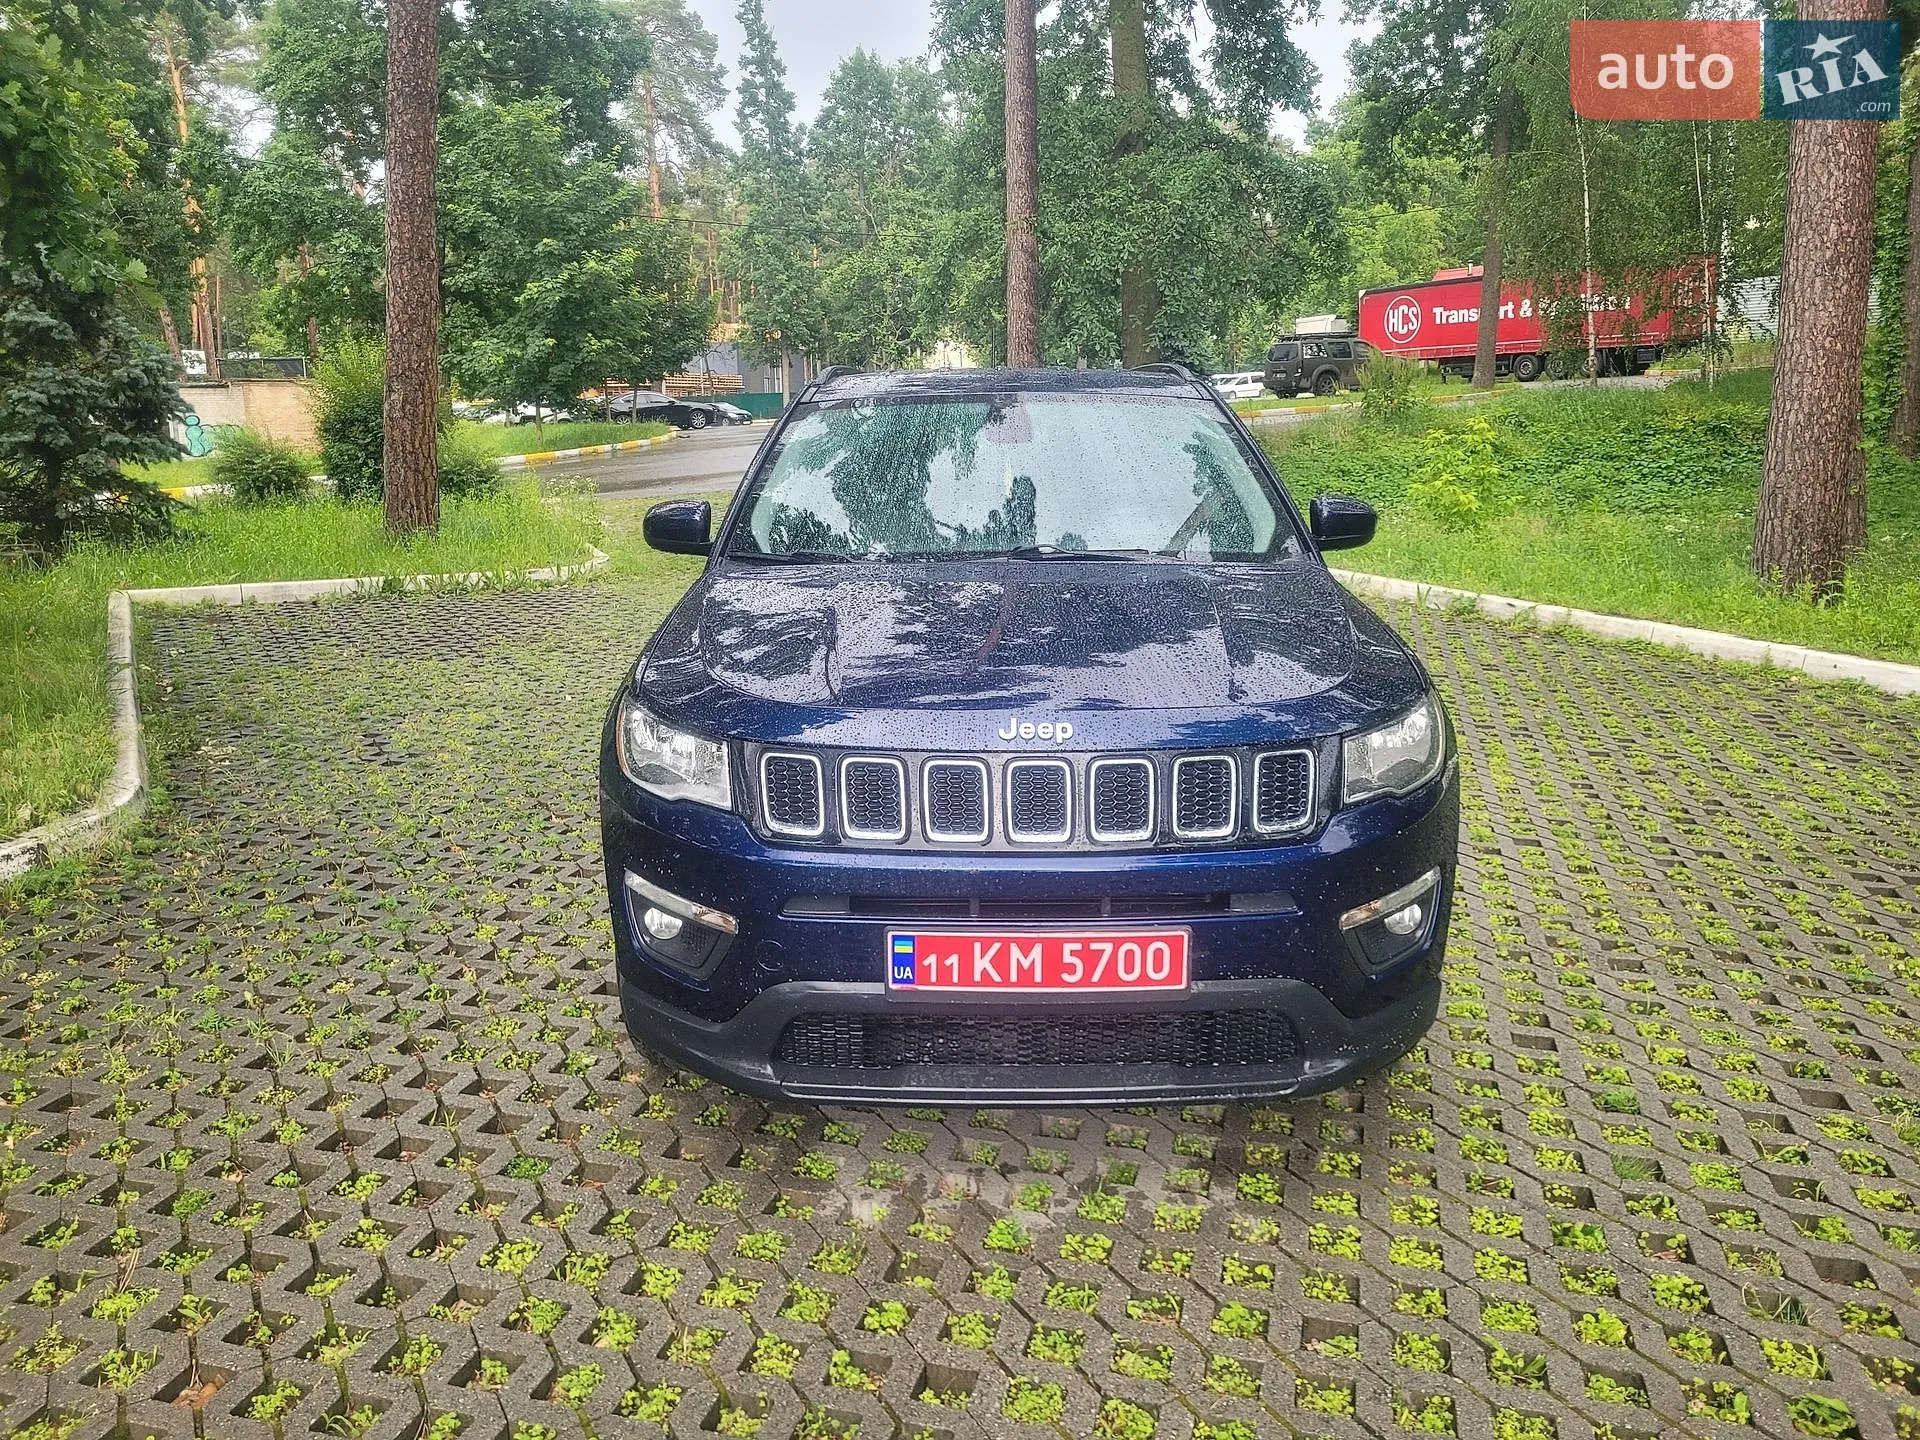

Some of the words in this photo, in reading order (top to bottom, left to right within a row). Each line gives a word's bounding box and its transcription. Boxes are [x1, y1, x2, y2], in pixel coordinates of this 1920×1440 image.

[1388, 304, 1419, 334] HCS
[1432, 301, 1515, 325] Transrt
[1519, 298, 1533, 318] &
[998, 717, 1074, 744] Jeep
[894, 966, 913, 980] UA
[1060, 941, 1171, 984] 5700
